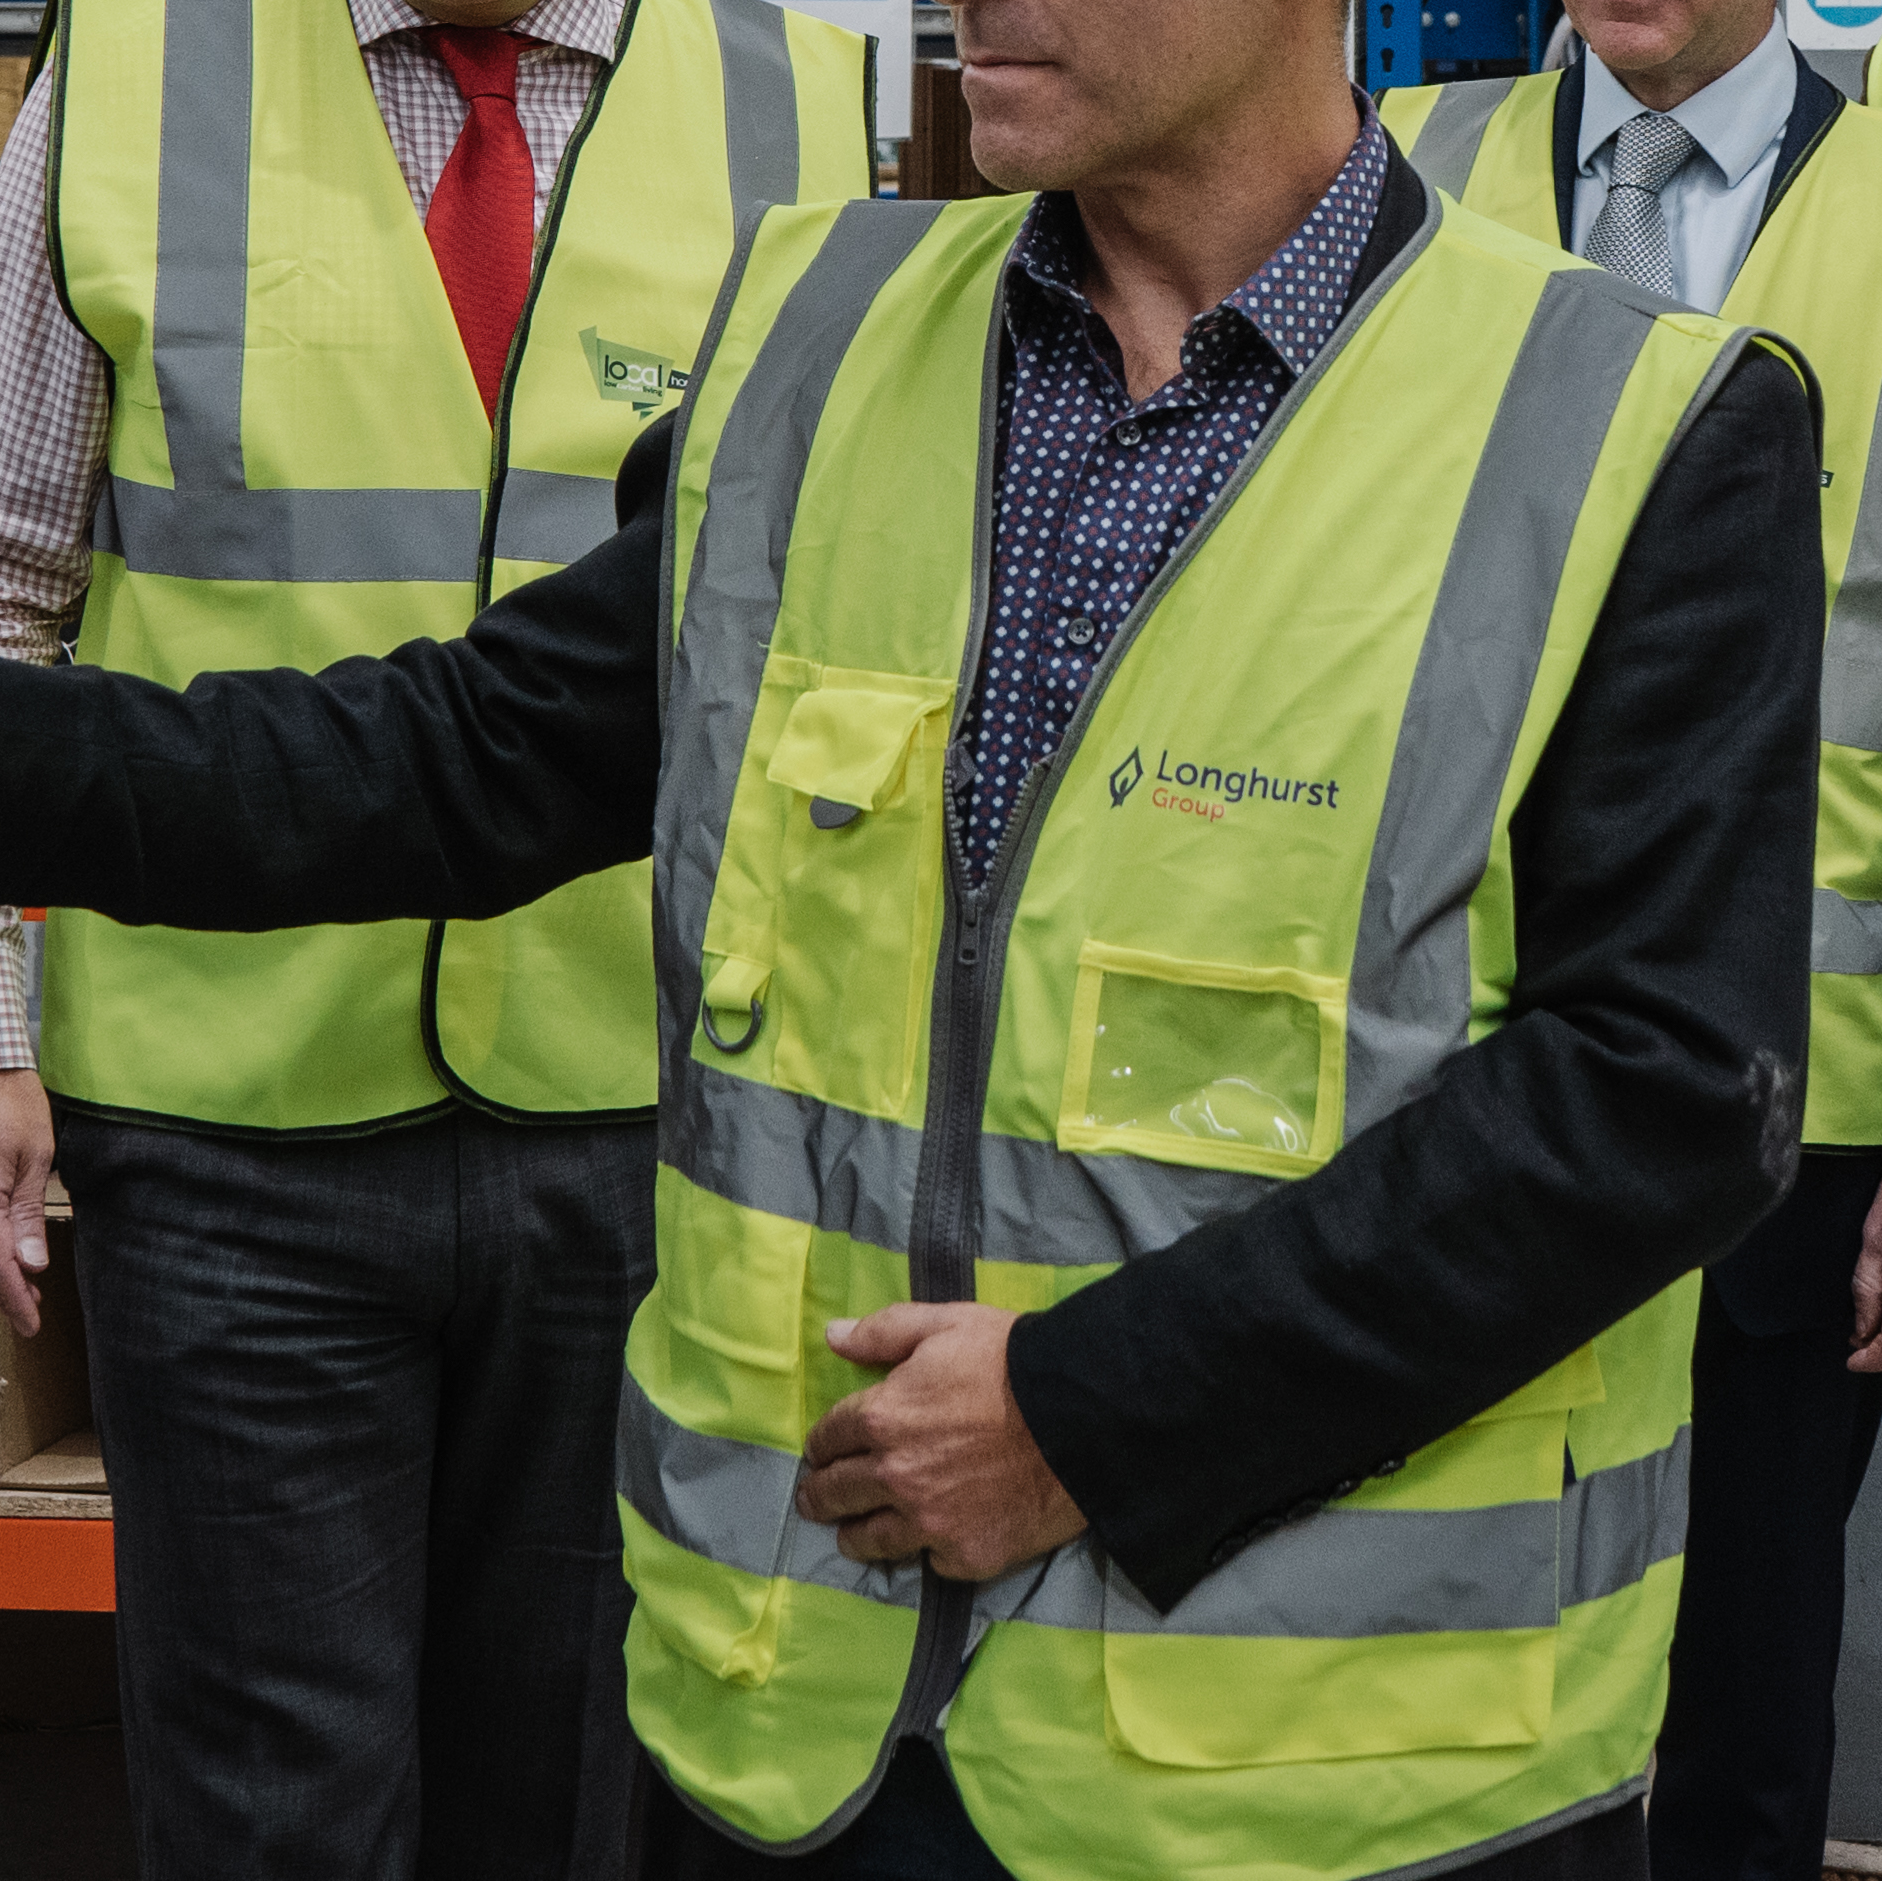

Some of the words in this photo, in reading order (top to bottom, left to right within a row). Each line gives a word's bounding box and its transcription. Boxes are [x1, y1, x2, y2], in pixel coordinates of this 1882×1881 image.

[604, 354, 663, 388] local
[1156, 749, 1340, 809] Longhurst
[1152, 787, 1226, 823] Group
